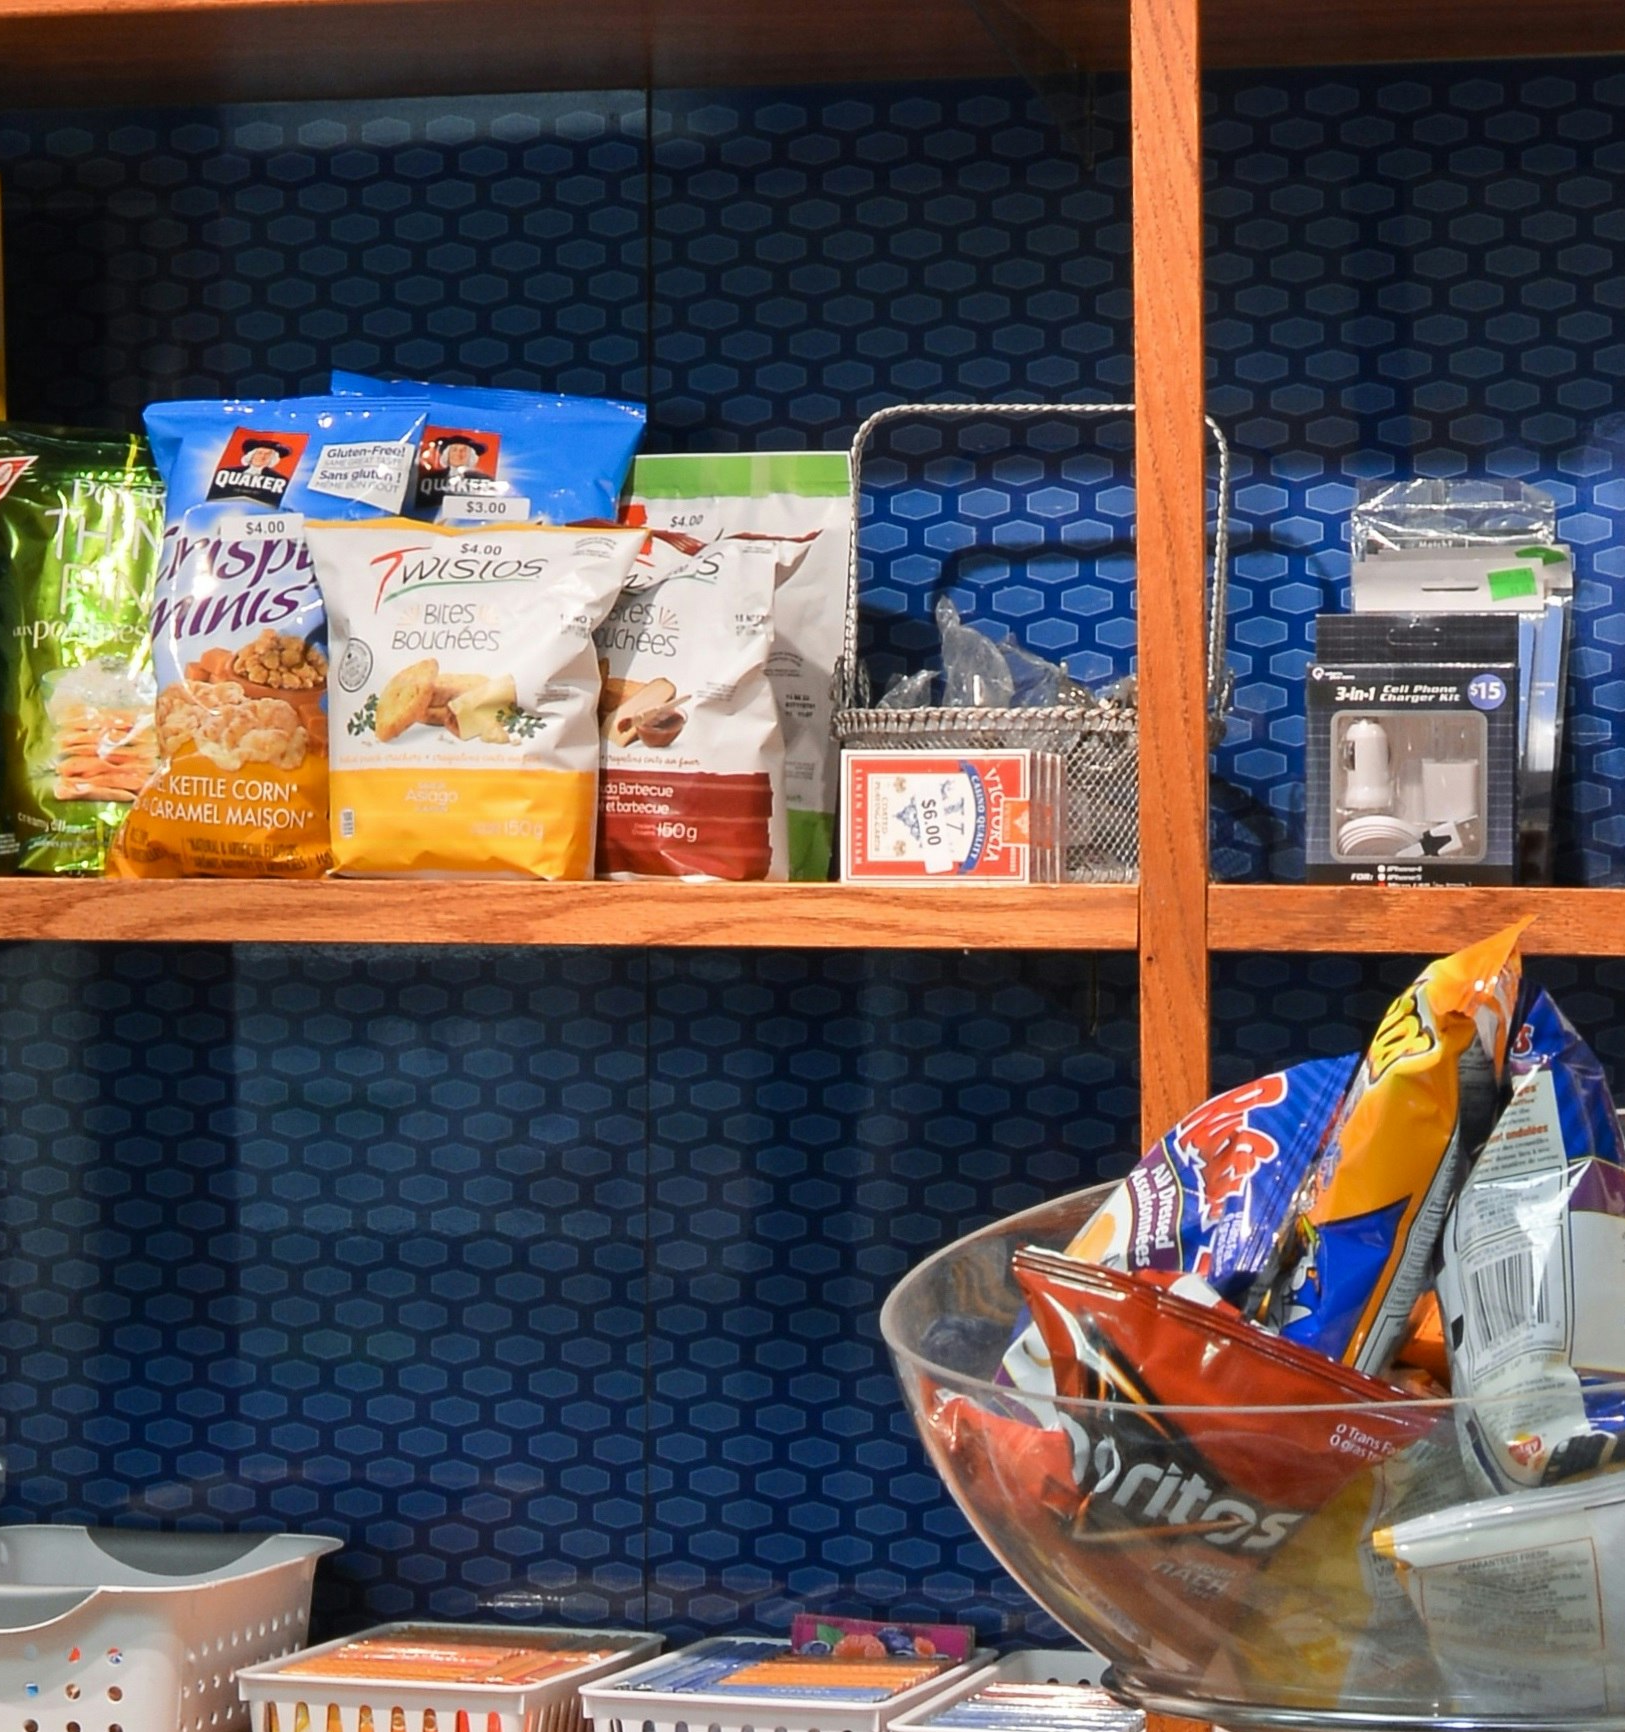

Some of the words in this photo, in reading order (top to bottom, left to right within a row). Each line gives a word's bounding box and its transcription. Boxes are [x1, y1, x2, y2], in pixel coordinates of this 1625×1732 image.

[215, 468, 288, 495] QUAKER
[466, 500, 506, 516] $3.00
[246, 520, 285, 536] $4.00
[670, 514, 703, 528] $4.00
[460, 542, 502, 556] $4.00
[1383, 685, 1409, 693] Cell
[1413, 685, 1457, 693] Phone
[1470, 682, 1501, 699] $15
[1380, 693, 1436, 703] Charger
[1440, 694, 1460, 702] Kit
[169, 776, 227, 801] KETTLE
[922, 799, 941, 845] $6.00
[1129, 1168, 1153, 1267] Assaisonnées
[1154, 1179, 1175, 1249] Dressed
